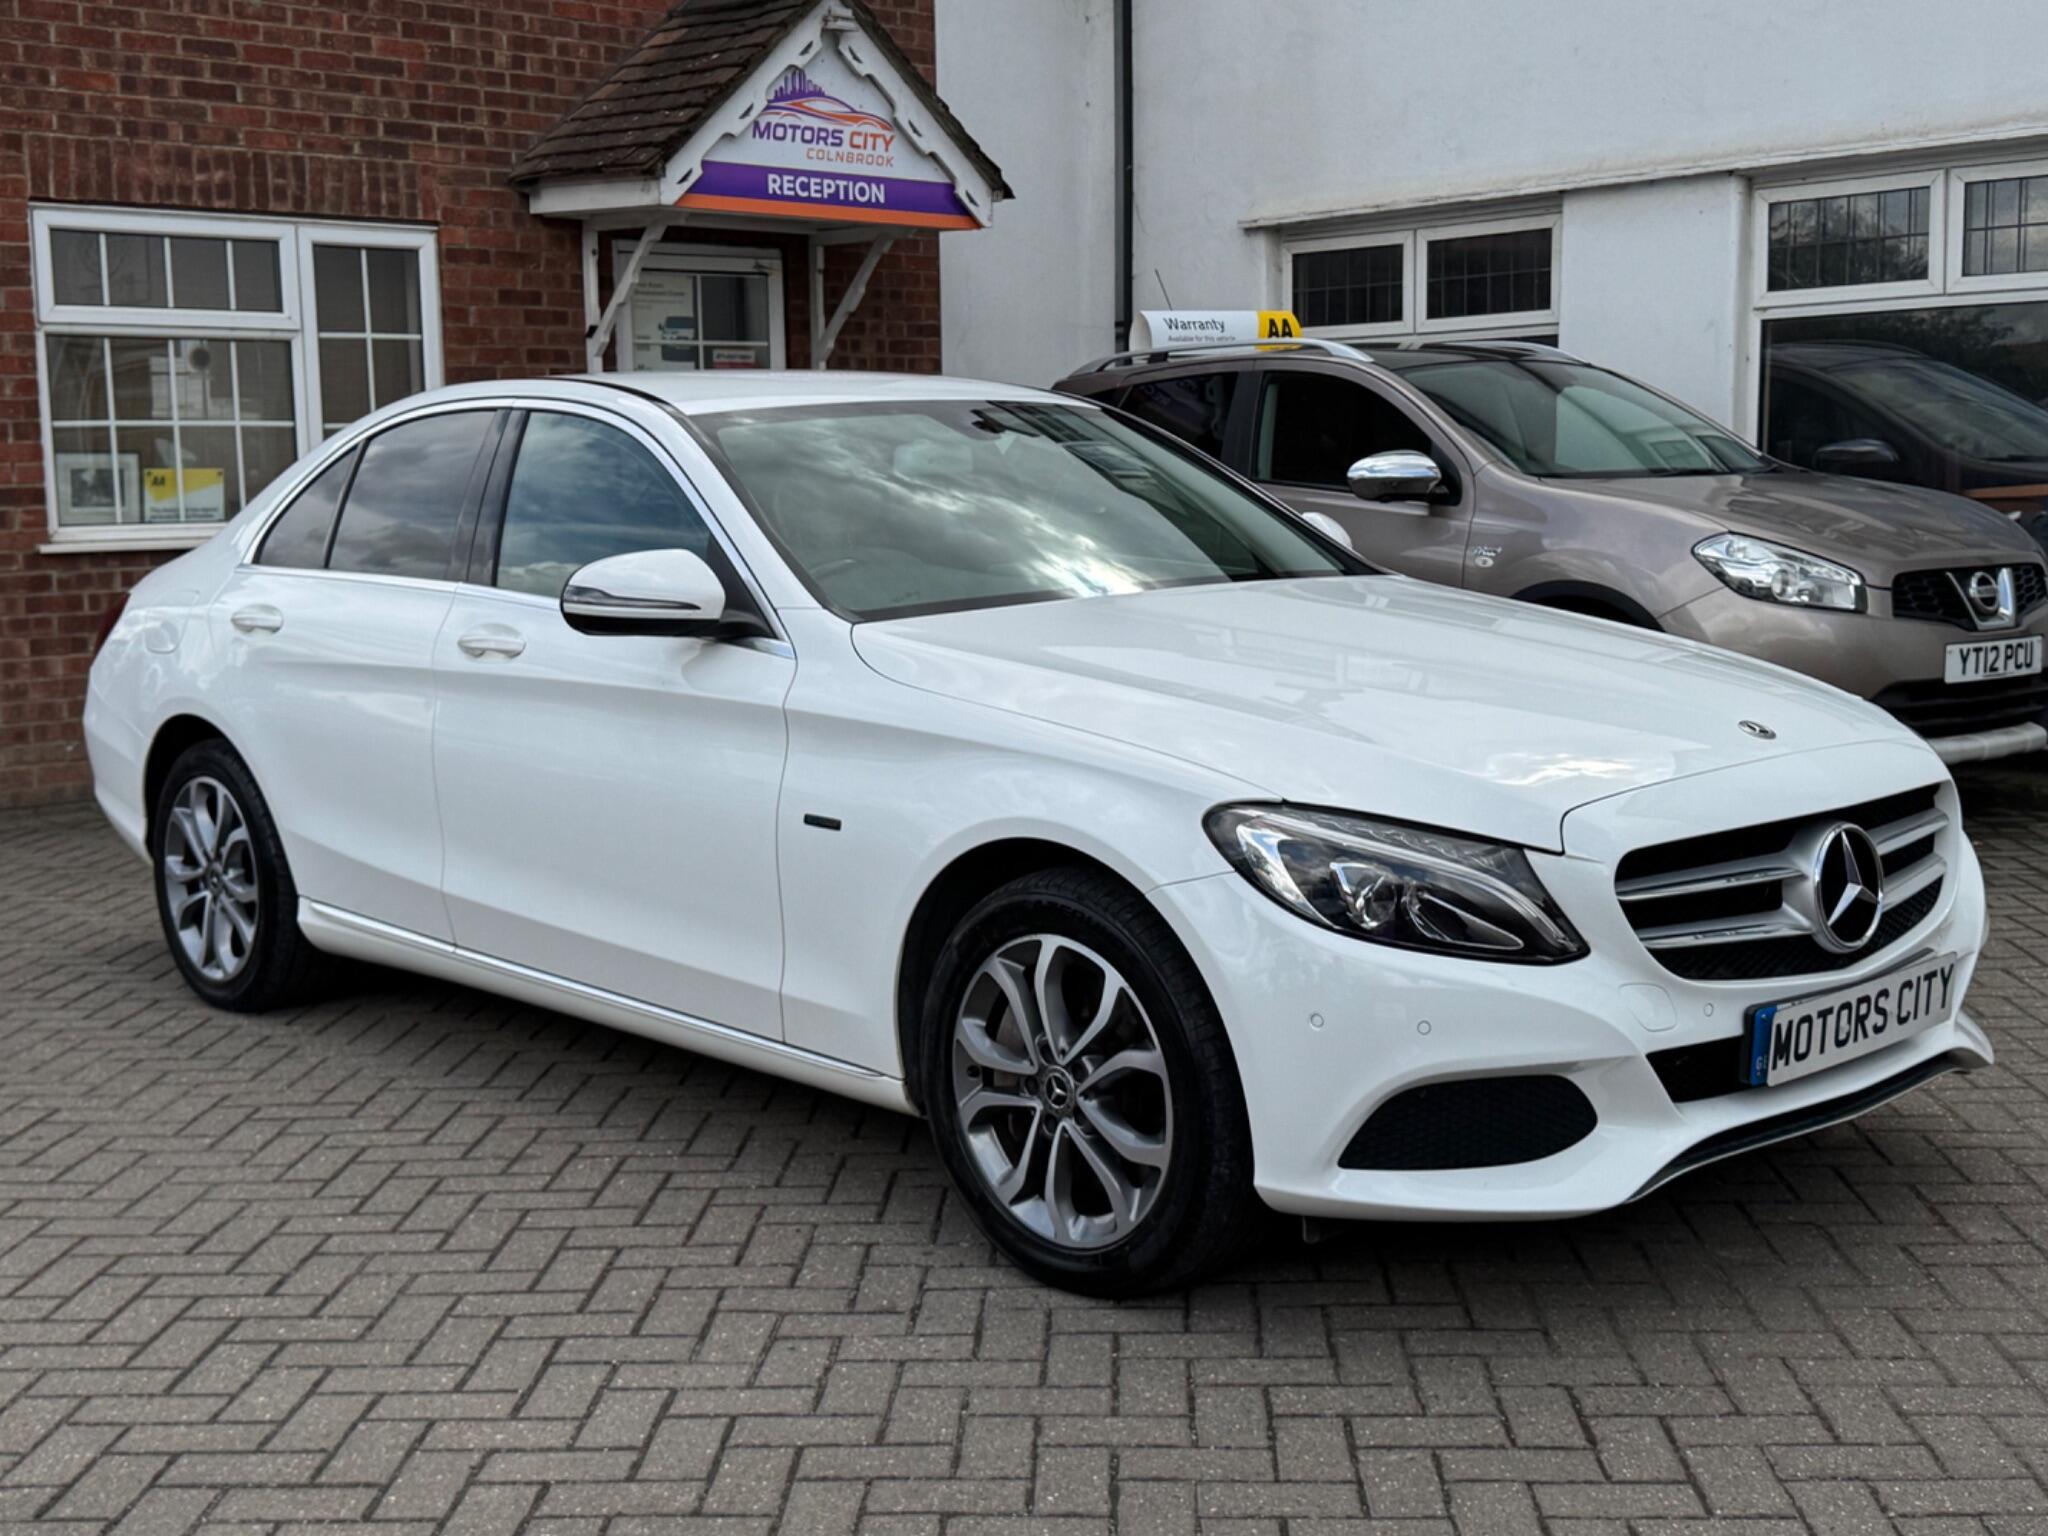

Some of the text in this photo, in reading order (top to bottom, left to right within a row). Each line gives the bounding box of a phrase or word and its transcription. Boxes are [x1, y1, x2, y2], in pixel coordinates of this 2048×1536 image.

[752, 120, 895, 152] MOTORS CITY
[806, 148, 894, 168] COLNBROOK
[768, 173, 886, 203] RECEPTION
[1163, 318, 1225, 333] Warranty
[1268, 318, 1293, 338] AA
[151, 475, 166, 487] AA
[1960, 641, 2034, 676] YT12 PCU
[1771, 964, 1954, 1071] MOTORS CITY
